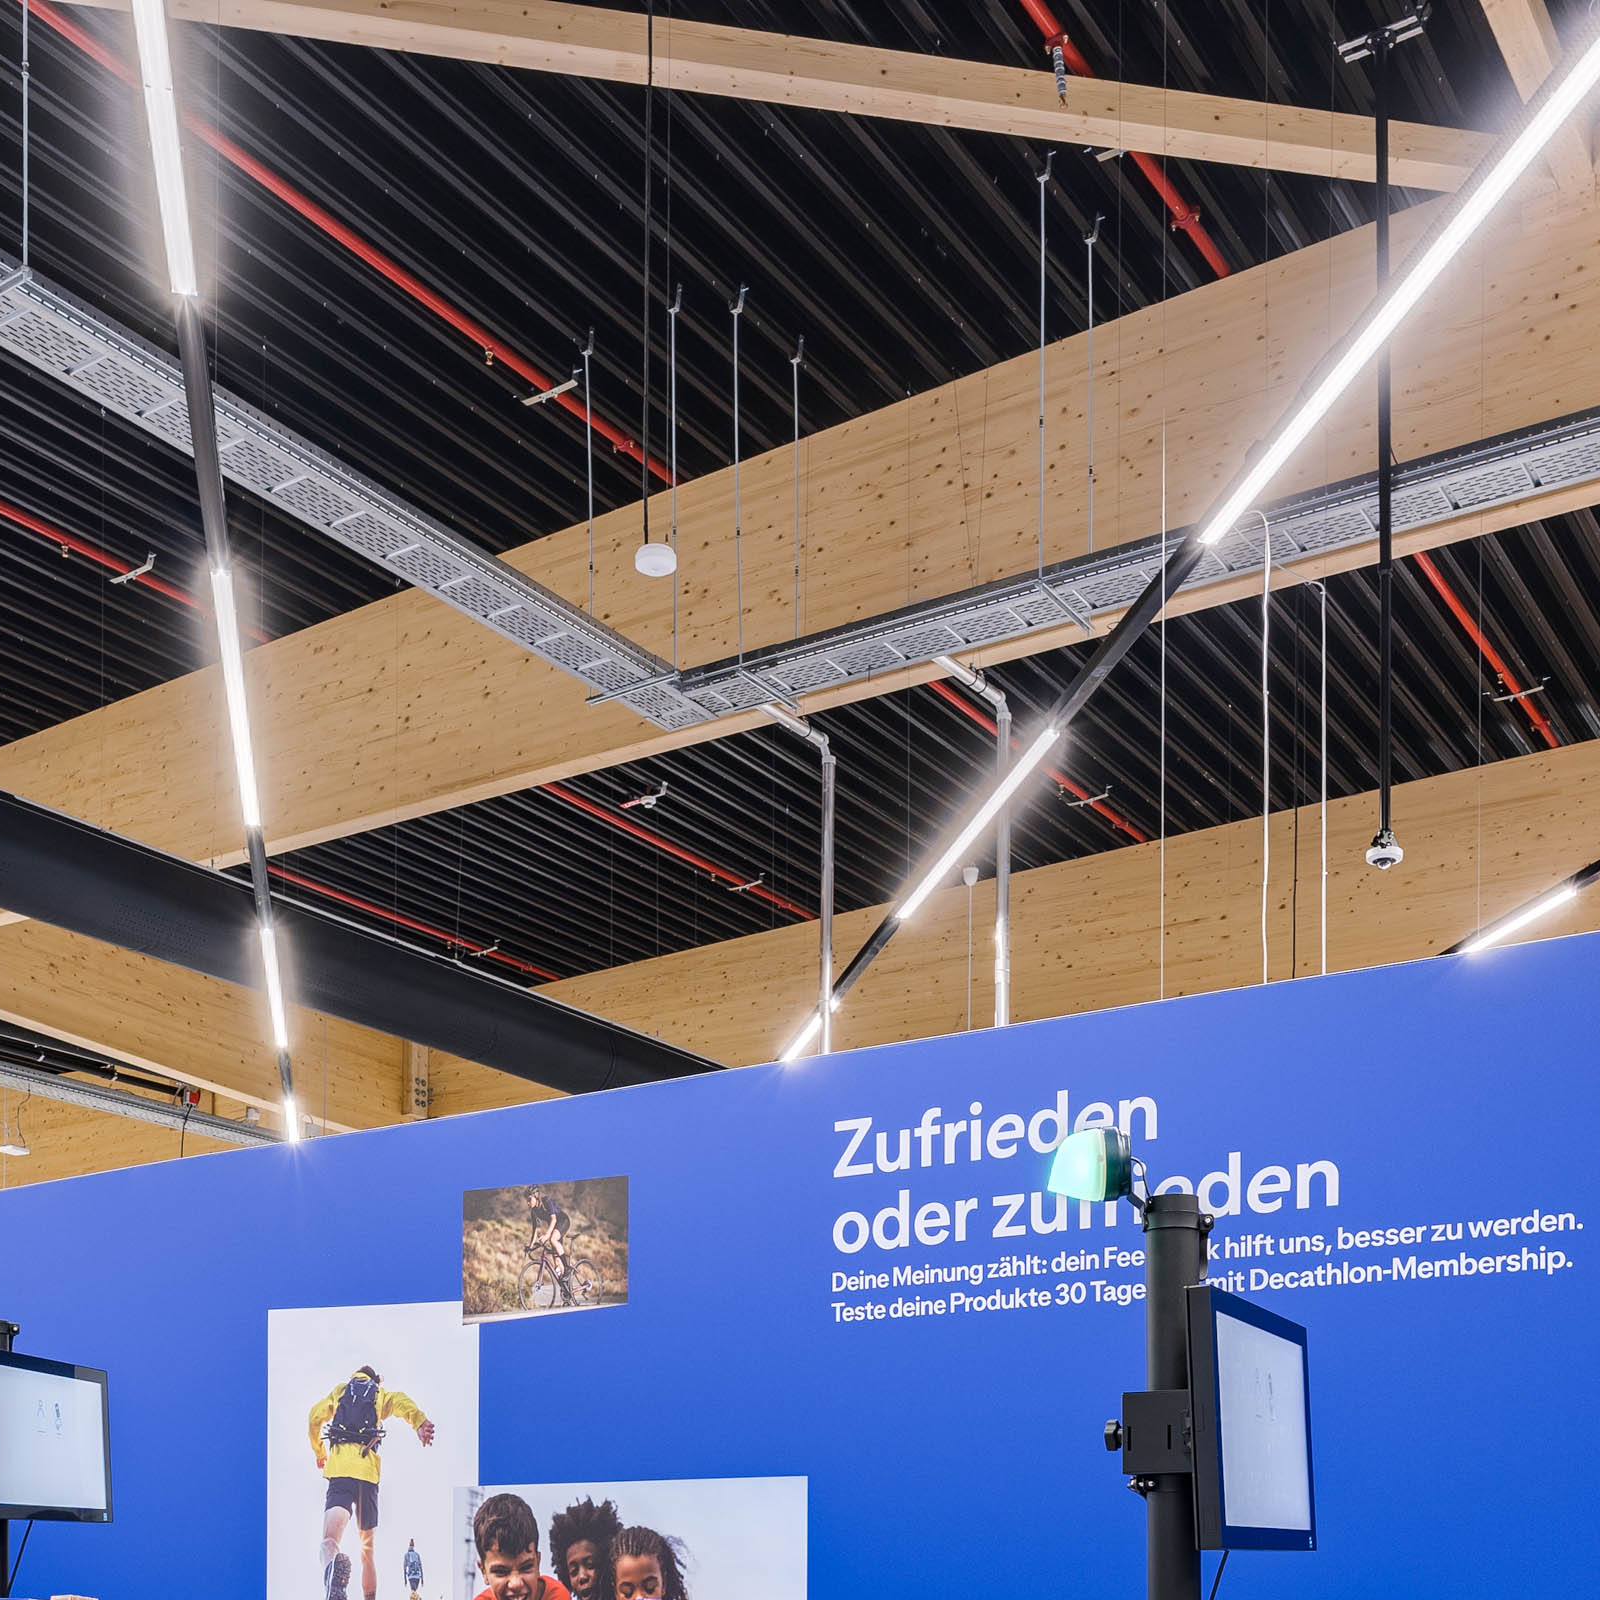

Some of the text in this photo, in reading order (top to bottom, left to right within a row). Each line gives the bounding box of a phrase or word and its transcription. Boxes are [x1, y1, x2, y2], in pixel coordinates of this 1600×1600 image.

[832, 1089, 1159, 1179] Zufrieden
[831, 1271, 890, 1292] Deine
[893, 1261, 984, 1288] Meinung
[987, 1253, 1048, 1281] zählt:
[1051, 1249, 1101, 1273] dein
[1224, 1233, 1275, 1260] hilft
[1279, 1234, 1333, 1257] uns,
[1337, 1223, 1427, 1250] besser
[1430, 1221, 1464, 1244] zu
[1467, 1208, 1584, 1239] werden.
[832, 1189, 980, 1254] oder
[831, 1245, 1574, 1323] Teste deine Produkte 30 Tage mit Decathlon-Membership.
